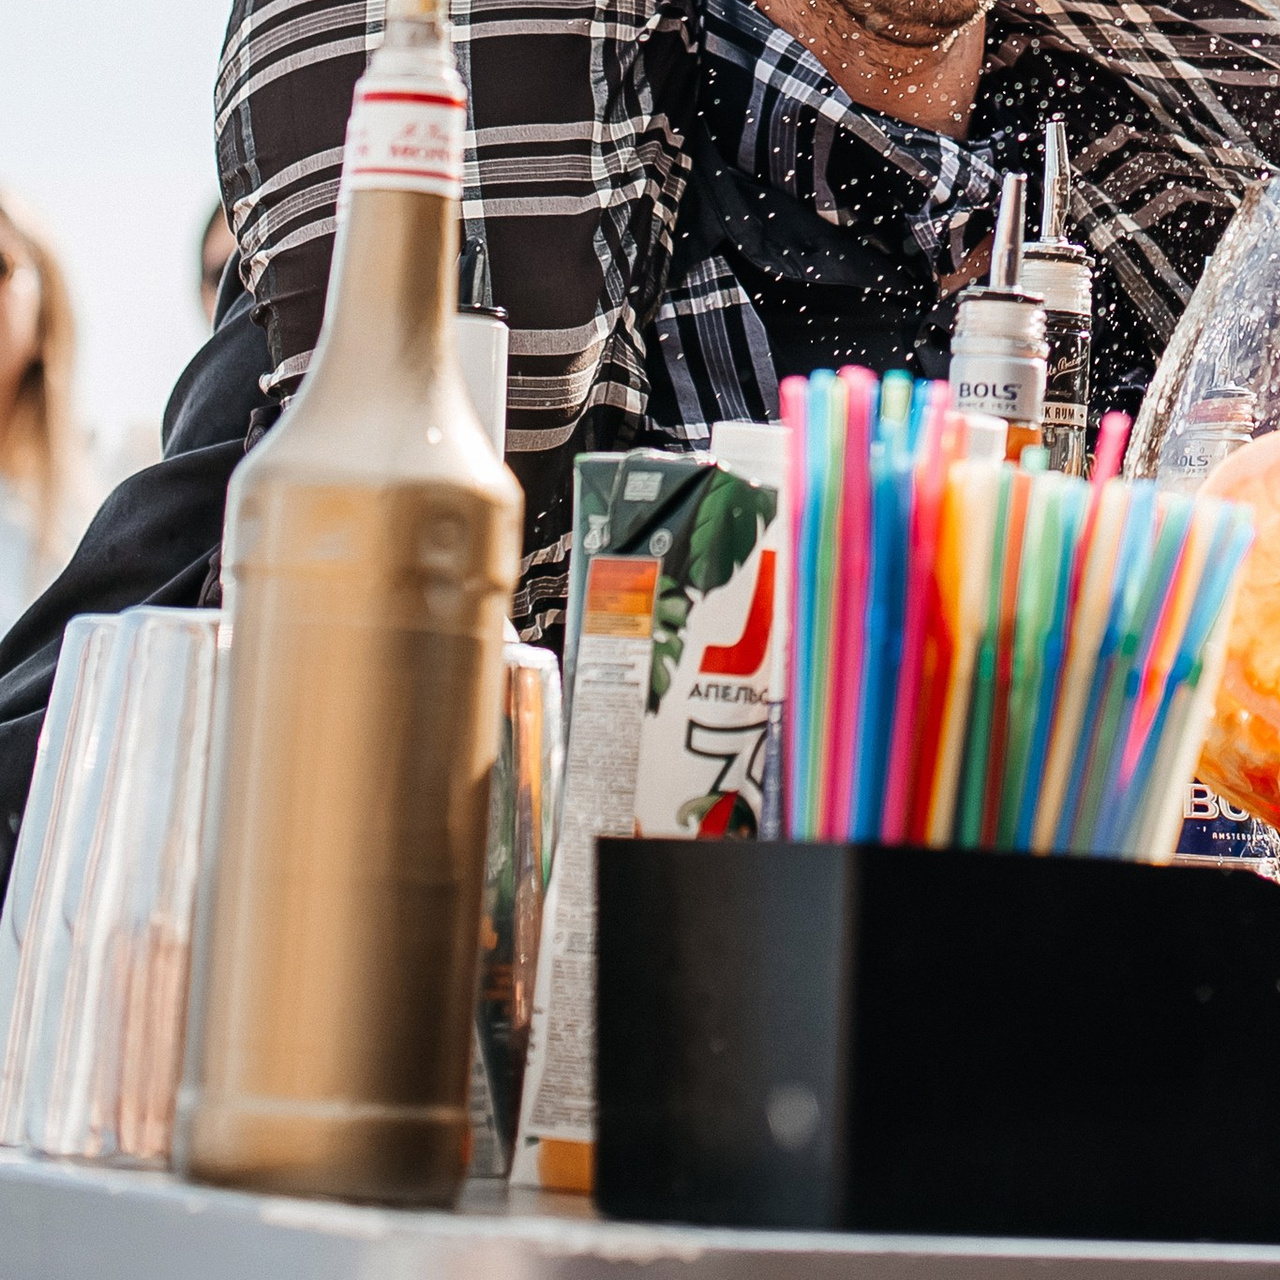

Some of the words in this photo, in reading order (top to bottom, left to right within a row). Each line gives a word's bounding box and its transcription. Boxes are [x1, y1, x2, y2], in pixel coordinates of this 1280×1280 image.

[959, 382, 1018, 401] BOLS
[1054, 407, 1075, 420] RUM
[688, 683, 769, 704] АПЕЛЬС
